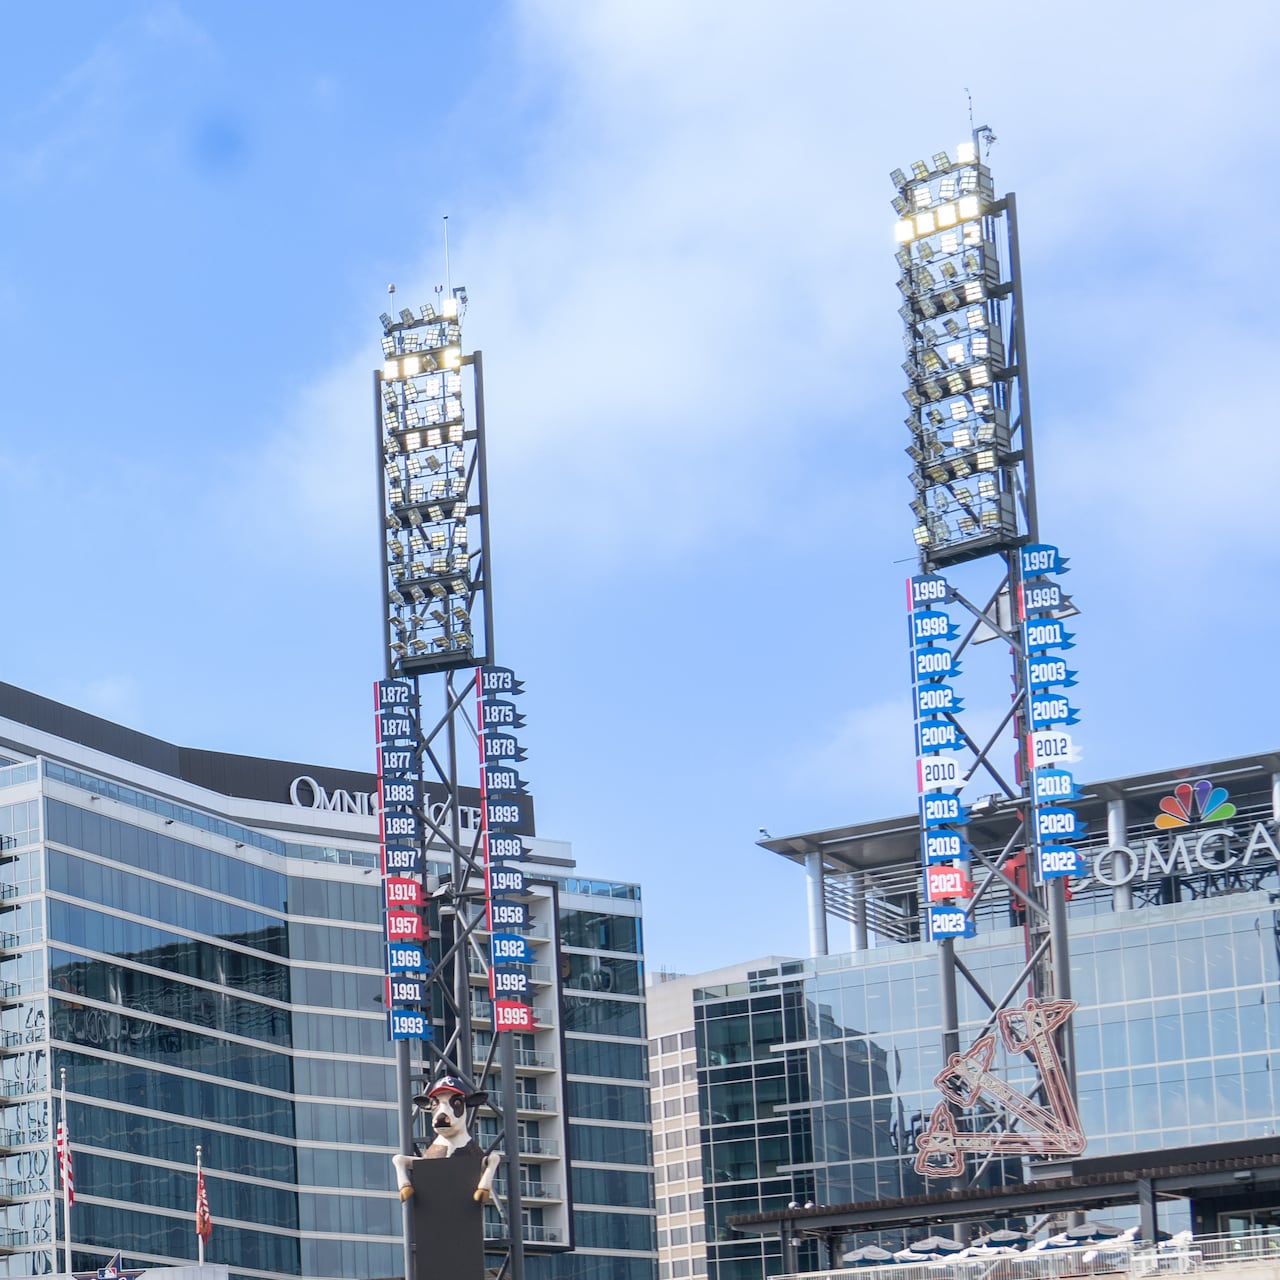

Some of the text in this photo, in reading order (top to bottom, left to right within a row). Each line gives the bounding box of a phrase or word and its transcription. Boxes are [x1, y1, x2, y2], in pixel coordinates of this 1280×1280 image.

[1023, 550, 1056, 571] 1997
[913, 580, 946, 600] 1996
[1026, 588, 1060, 607] 1999
[915, 617, 949, 636] 1998
[1028, 624, 1062, 644] 2001
[917, 654, 951, 672] 2000
[1030, 662, 1066, 682] 2003
[482, 672, 512, 689] 1873
[381, 686, 409, 703] 1872
[919, 689, 953, 708] 2002
[484, 706, 514, 722] 1875
[1032, 700, 1068, 720] 2005
[382, 719, 410, 736] 1874
[921, 726, 955, 744] 2004
[486, 739, 515, 755] 1878
[1036, 738, 1068, 756] 2012
[383, 752, 411, 768] 1877
[487, 772, 516, 789] 1891
[925, 763, 955, 782] 2010
[385, 784, 414, 802] 1883
[1037, 776, 1071, 796] 2018
[488, 805, 519, 822] 1893
[926, 800, 958, 818] 2013
[386, 817, 415, 834] 1892
[1040, 814, 1074, 833] 2020
[490, 839, 520, 856] 1898
[928, 836, 960, 855] 2019
[1093, 823, 1280, 886] OMCA
[387, 850, 415, 867] 1897
[1042, 852, 1076, 871] 2022
[491, 872, 522, 889] 1948
[929, 874, 963, 892] 2021
[388, 883, 416, 900] 1914
[493, 906, 523, 923] 1958
[932, 913, 965, 932] 2023
[389, 917, 418, 933] 1957
[494, 939, 525, 957] 1982
[391, 950, 421, 967] 1969
[496, 973, 526, 990] 1992
[392, 983, 421, 1000] 1991
[393, 1016, 423, 1033] 1993
[497, 1007, 528, 1025] 1995
